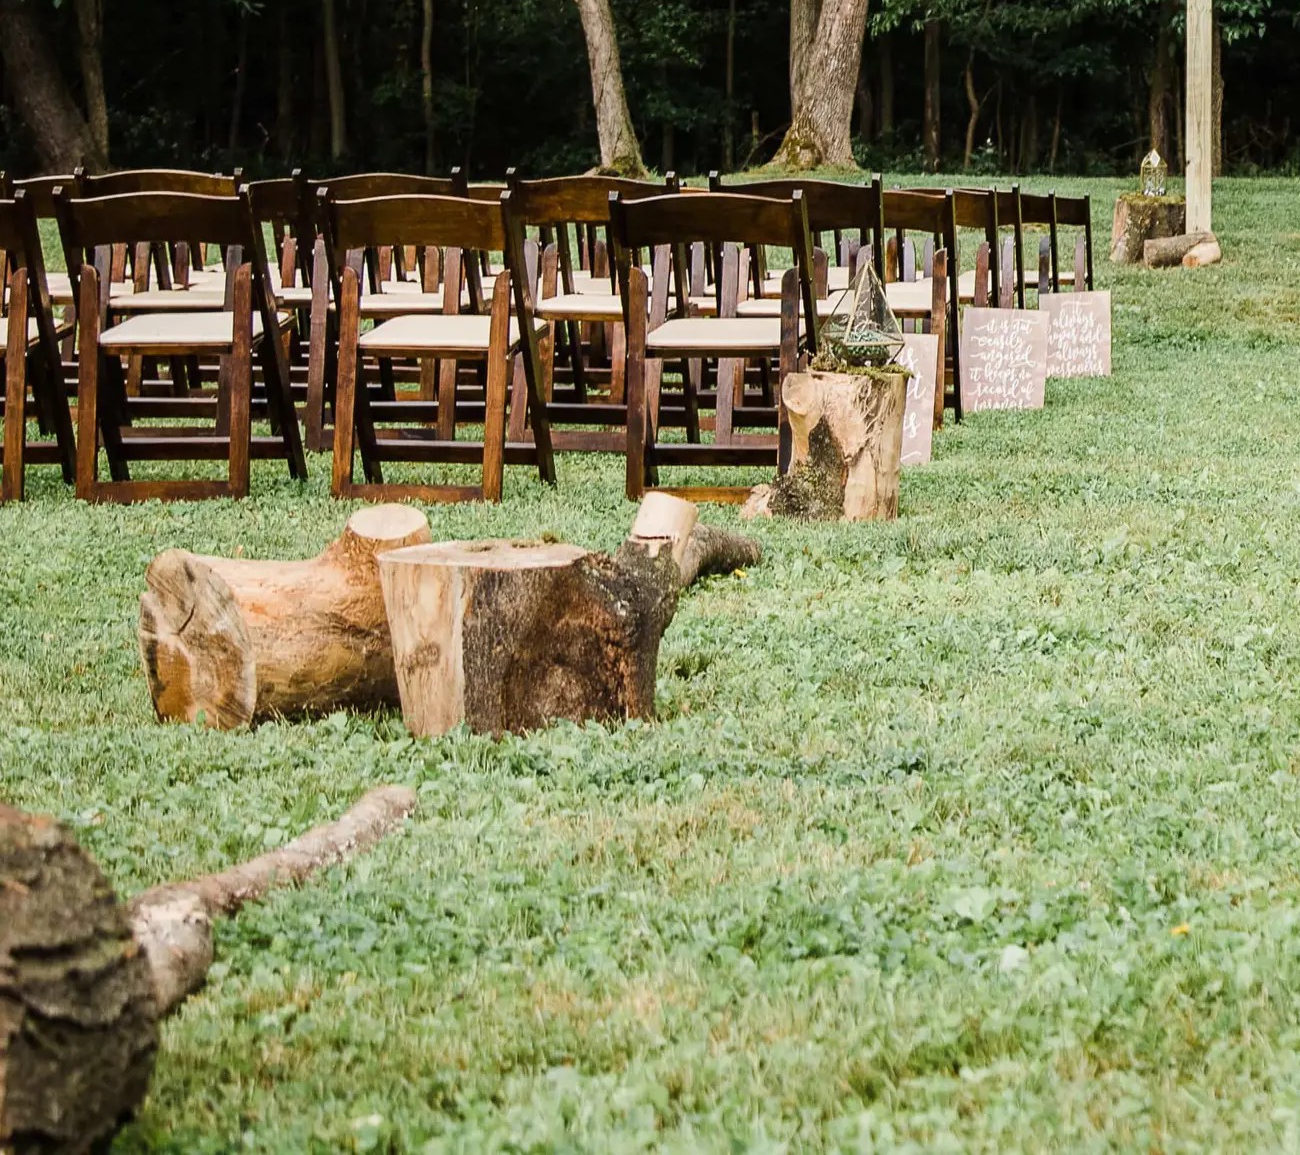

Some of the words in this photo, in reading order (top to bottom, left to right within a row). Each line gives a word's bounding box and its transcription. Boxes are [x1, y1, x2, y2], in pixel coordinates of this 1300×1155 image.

[1053, 309, 1096, 334] always
[970, 345, 1037, 369] angered
[1048, 340, 1099, 363] always
[967, 379, 1019, 398] record
[1020, 381, 1034, 400] of
